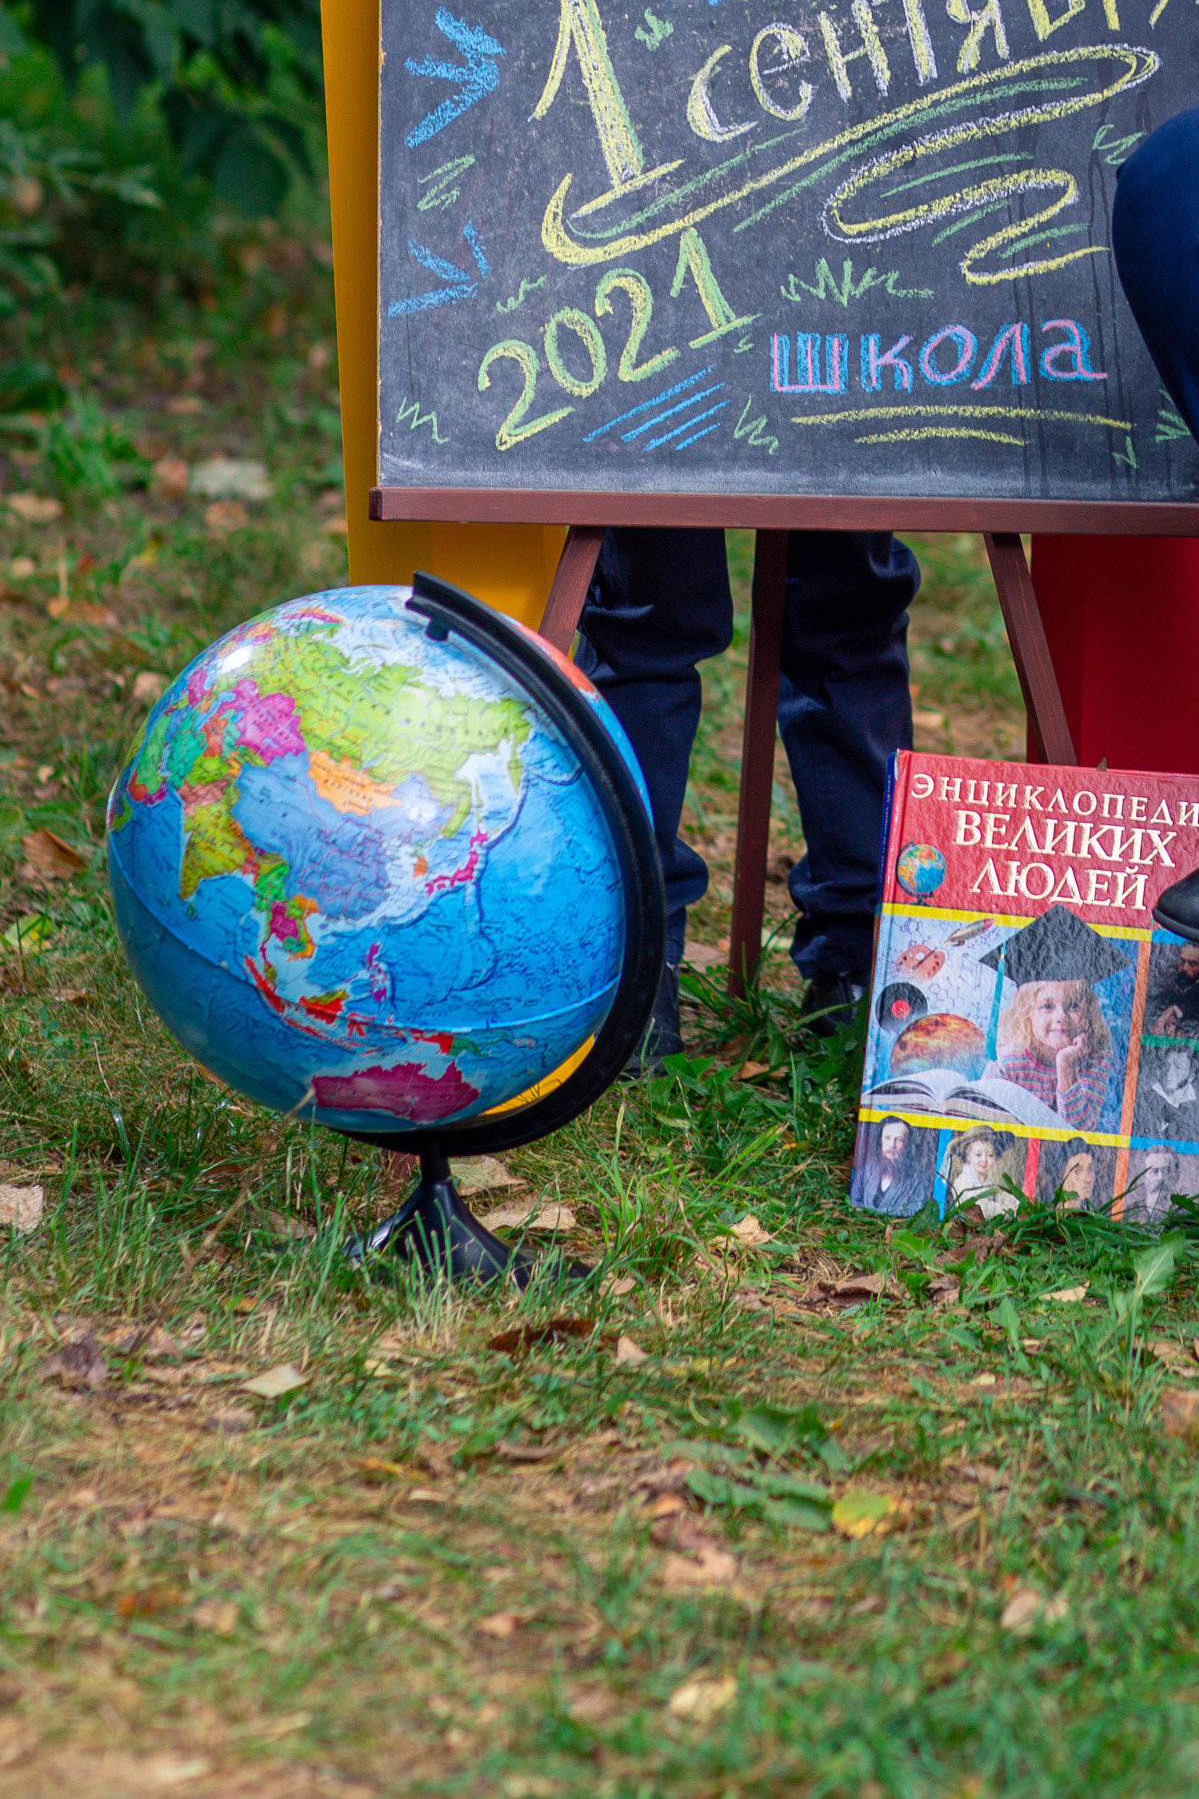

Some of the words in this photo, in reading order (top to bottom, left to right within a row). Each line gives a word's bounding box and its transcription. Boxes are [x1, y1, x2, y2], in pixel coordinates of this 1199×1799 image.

[477, 228, 762, 450] 2021
[954, 809, 1176, 867] ВЕЛИКИХ
[971, 858, 1149, 910] ЛЮДЕЙ
